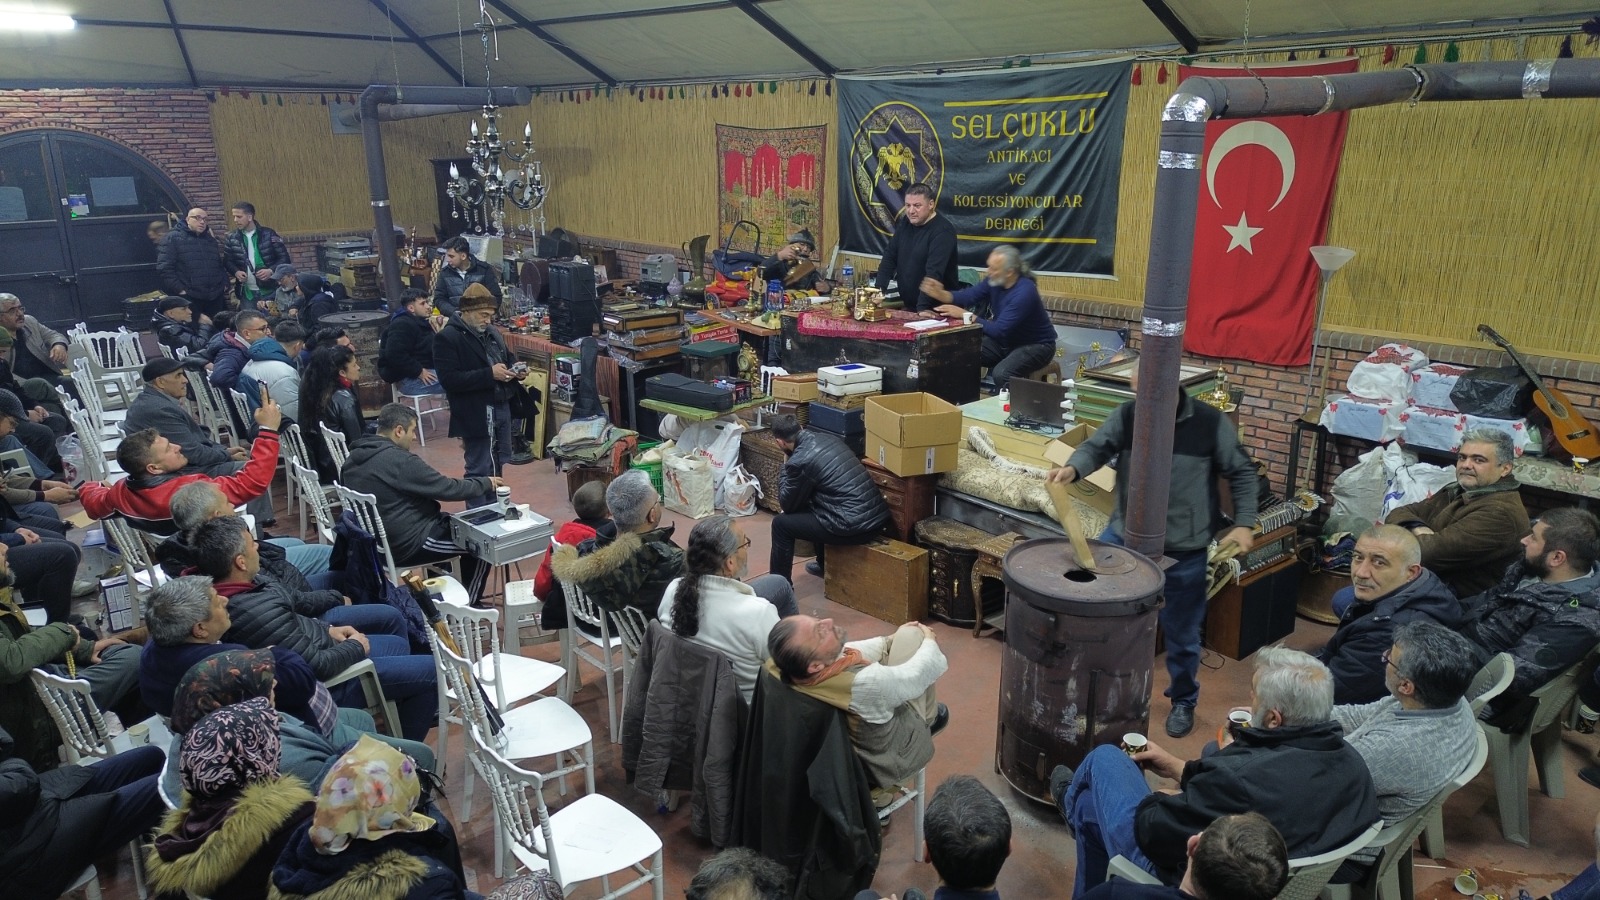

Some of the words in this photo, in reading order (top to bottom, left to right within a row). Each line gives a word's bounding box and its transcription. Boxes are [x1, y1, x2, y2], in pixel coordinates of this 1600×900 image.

[951, 107, 1096, 143] SELÇUKLU
[987, 148, 1051, 164] ANTİKACI
[1009, 173, 1026, 186] VE
[953, 193, 1082, 208] KOLEKSİYONCULAR
[985, 215, 1044, 231] DERNEĞİ
